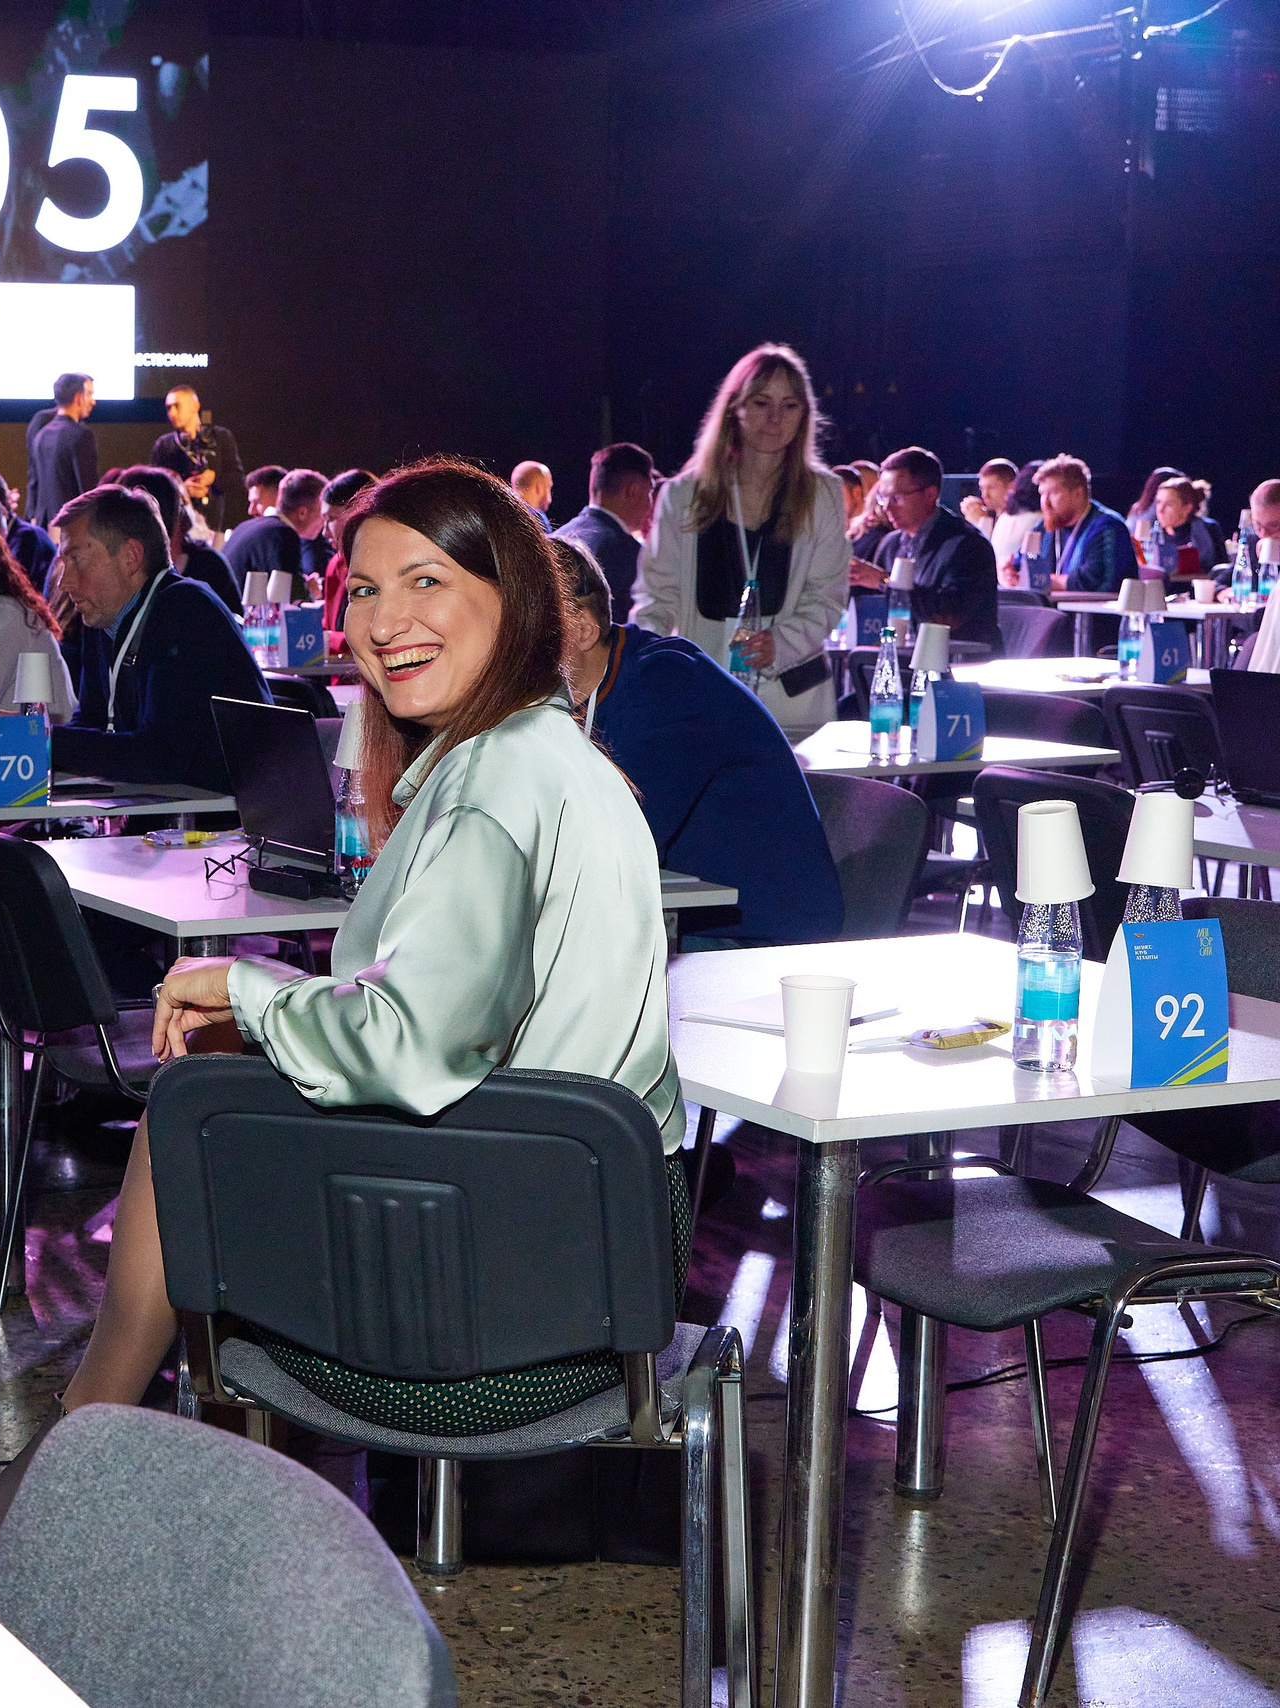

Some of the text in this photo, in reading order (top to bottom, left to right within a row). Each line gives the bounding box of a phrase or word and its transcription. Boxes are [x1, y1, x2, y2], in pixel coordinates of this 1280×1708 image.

[295, 633, 316, 651] 49
[1161, 648, 1179, 666] 61
[946, 714, 971, 738] 71
[0, 754, 35, 782] 70
[1155, 992, 1205, 1041] 92
